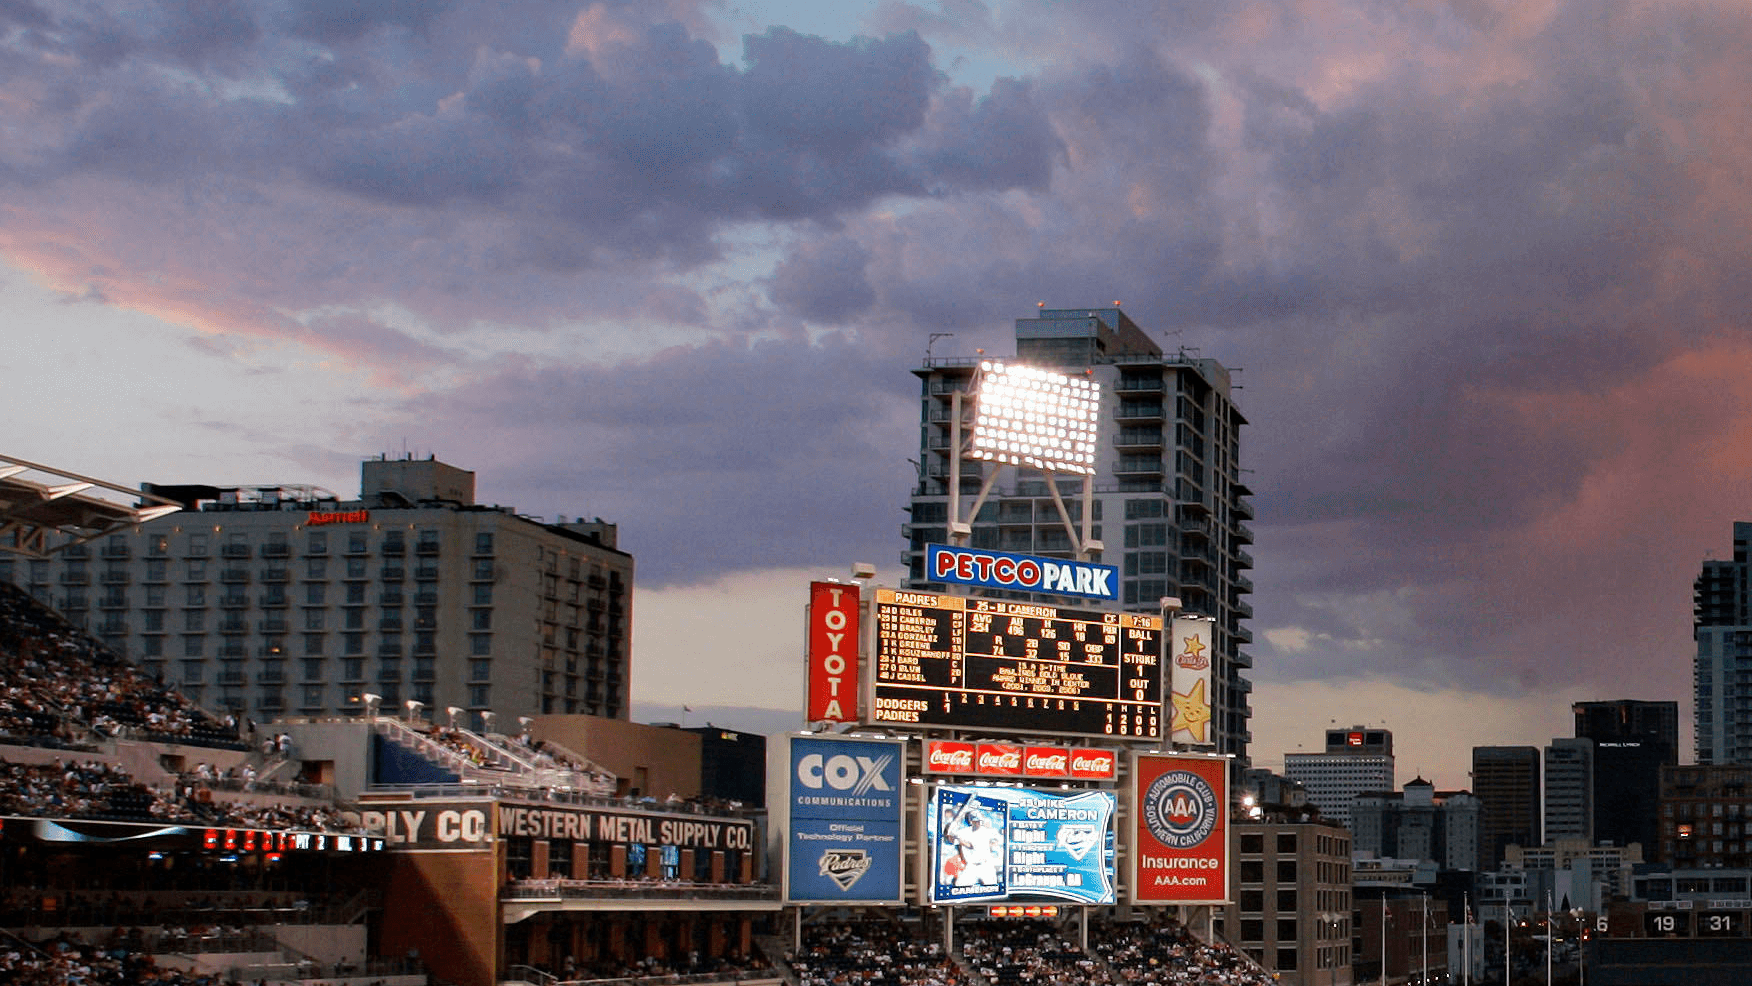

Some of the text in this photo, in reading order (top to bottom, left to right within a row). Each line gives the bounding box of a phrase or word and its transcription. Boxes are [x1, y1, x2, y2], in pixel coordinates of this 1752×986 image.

[936, 550, 1111, 596] PETCO PARK
[895, 592, 937, 606] PADRES
[1008, 605, 1056, 617] CAMERON
[972, 614, 992, 623] AVG
[1132, 617, 1150, 627] 7:16
[1041, 629, 1056, 639] 126
[1129, 630, 1152, 640] BALL
[995, 636, 1002, 645] R
[1138, 641, 1143, 652] 1
[824, 588, 847, 719] TOYOTA
[1124, 654, 1156, 665] STRIKE
[1138, 666, 1143, 676] 1
[1130, 679, 1149, 689] OUT
[1136, 690, 1144, 701] 0
[876, 698, 928, 711] DODGERS
[944, 703, 950, 713] 1
[876, 710, 919, 722] PADRES
[798, 753, 894, 796] COX
[1149, 774, 1213, 803] AUTOMOBILE CLUB
[798, 796, 891, 808] COMMUNICATIONS
[1164, 798, 1197, 817] AAA
[1027, 808, 1098, 821] CAMERON
[437, 810, 492, 842] CO.
[500, 808, 751, 849] WESTERN METAL SUPPLY CO.
[829, 824, 864, 832] Official
[1146, 805, 1215, 846] SOUTHERN CALIFORNIA
[797, 832, 895, 842] Technology Partner
[819, 853, 871, 874] Padres
[1142, 854, 1218, 869] Insurance
[1154, 875, 1207, 886] AAA.com
[1597, 916, 1608, 931] 6
[1654, 916, 1674, 931] 19
[1710, 916, 1730, 930] 31
